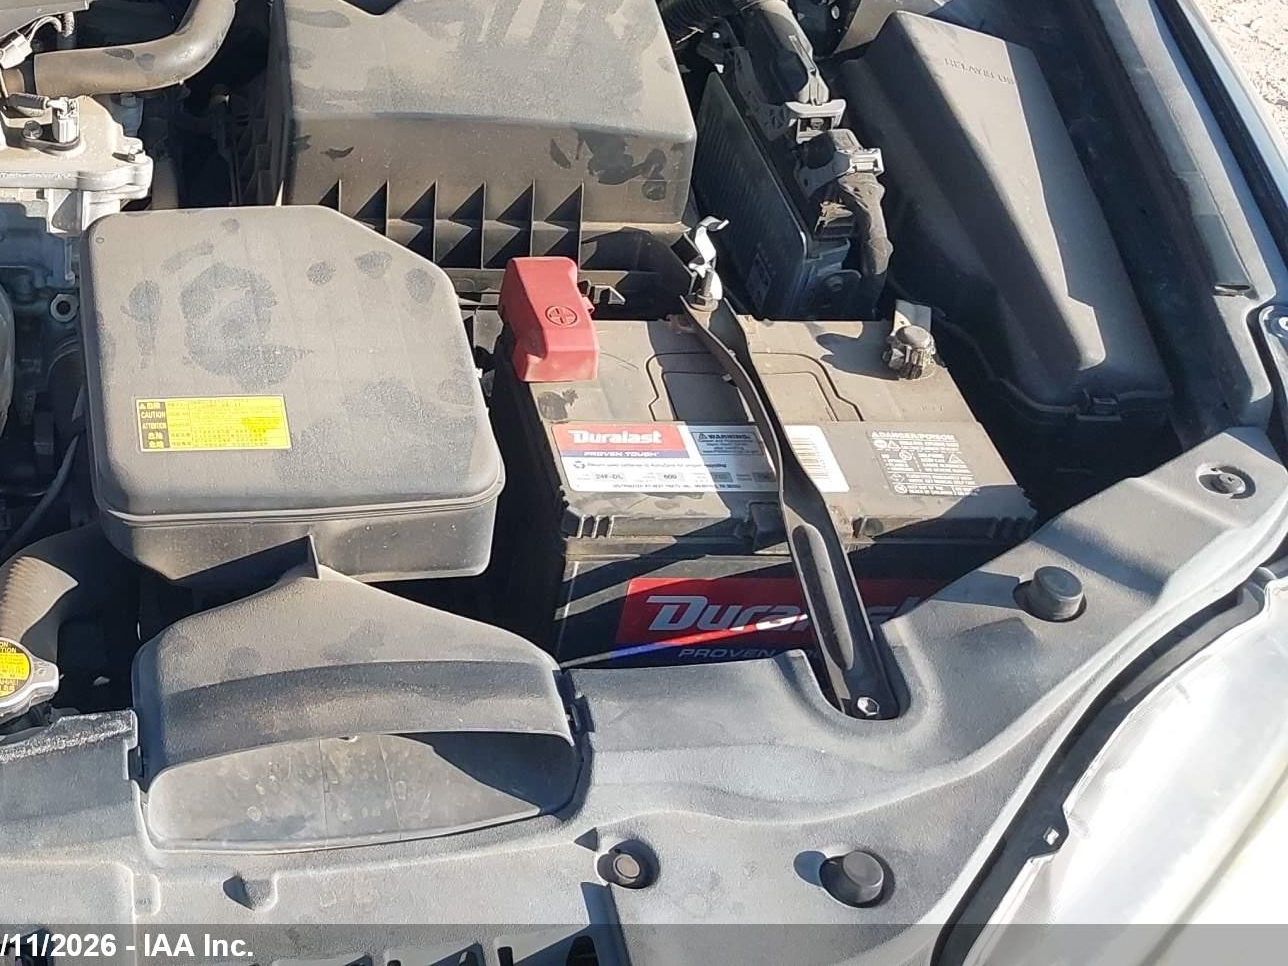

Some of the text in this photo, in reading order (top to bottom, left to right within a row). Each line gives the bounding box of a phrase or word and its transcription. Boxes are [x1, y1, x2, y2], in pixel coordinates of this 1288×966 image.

[140, 411, 166, 419] CAUTION
[568, 429, 663, 444] Duralast
[678, 648, 776, 659] PROVEN
